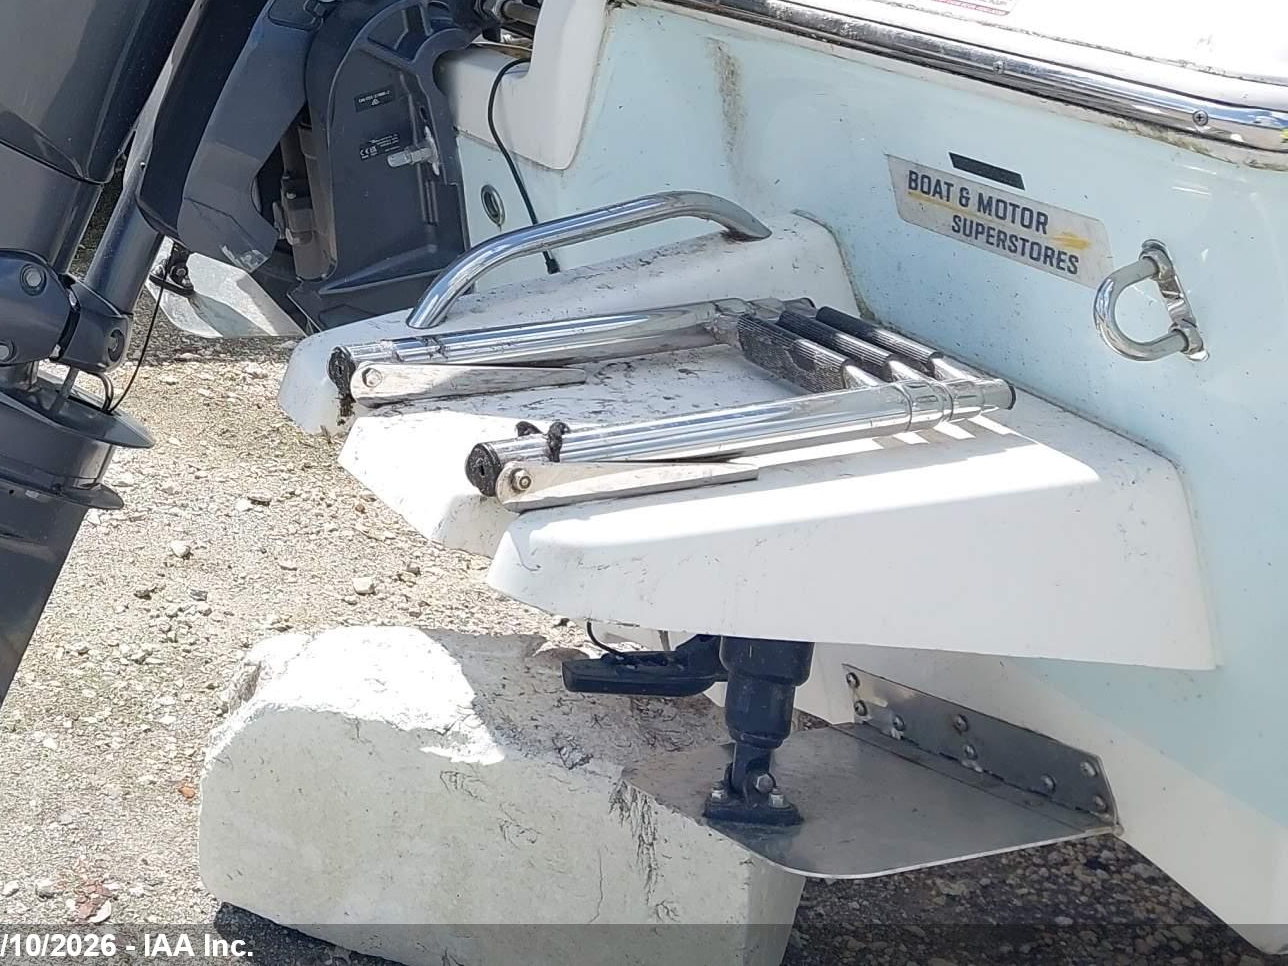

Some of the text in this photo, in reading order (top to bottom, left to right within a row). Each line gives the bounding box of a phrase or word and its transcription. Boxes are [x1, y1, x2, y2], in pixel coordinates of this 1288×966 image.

[907, 170, 1049, 235] BOAT & MOTOR
[951, 214, 1080, 275] SUPERSTORES
